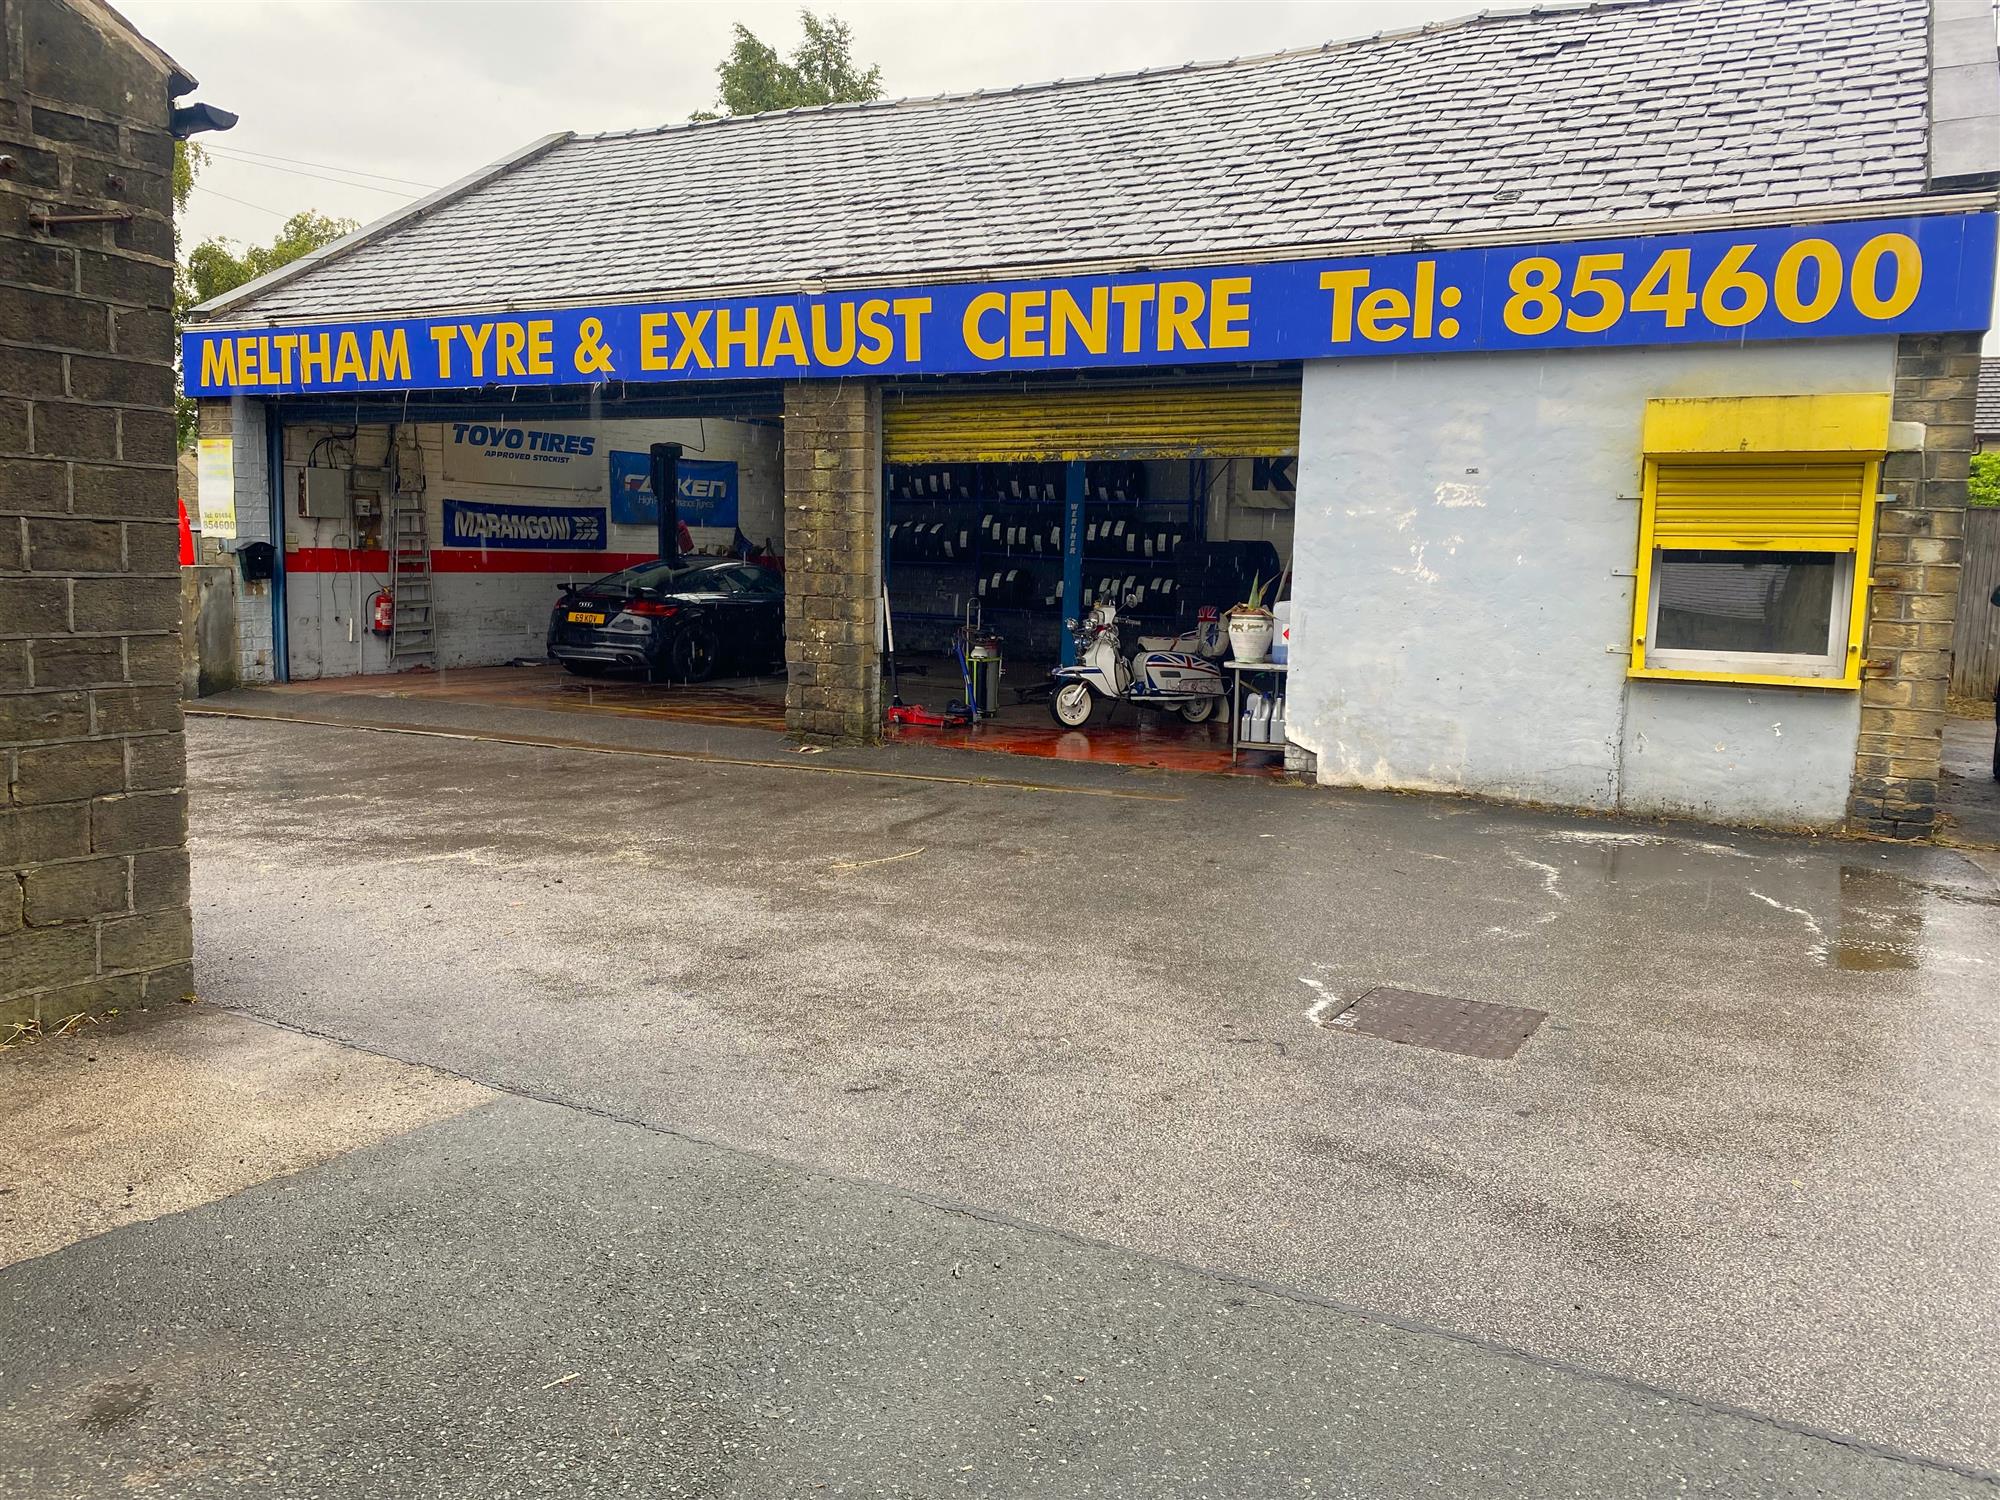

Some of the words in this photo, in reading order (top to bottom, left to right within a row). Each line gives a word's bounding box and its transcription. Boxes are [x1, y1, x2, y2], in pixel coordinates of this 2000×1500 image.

[201, 329, 411, 386] MELTHAM
[431, 320, 553, 378] TYRE
[574, 317, 614, 374] &
[641, 297, 934, 371] EXHAUST
[963, 277, 1252, 360] CENTRE
[1320, 261, 1461, 342] Tel:
[1503, 234, 1923, 335] 854600
[453, 424, 524, 449] TOYO
[528, 431, 596, 456] TIRES
[484, 450, 530, 461] APPROVED
[533, 454, 570, 464] STOCKIST
[624, 474, 727, 498] FAKEN
[203, 520, 235, 530] 854600
[454, 511, 570, 541] MARANGONI
